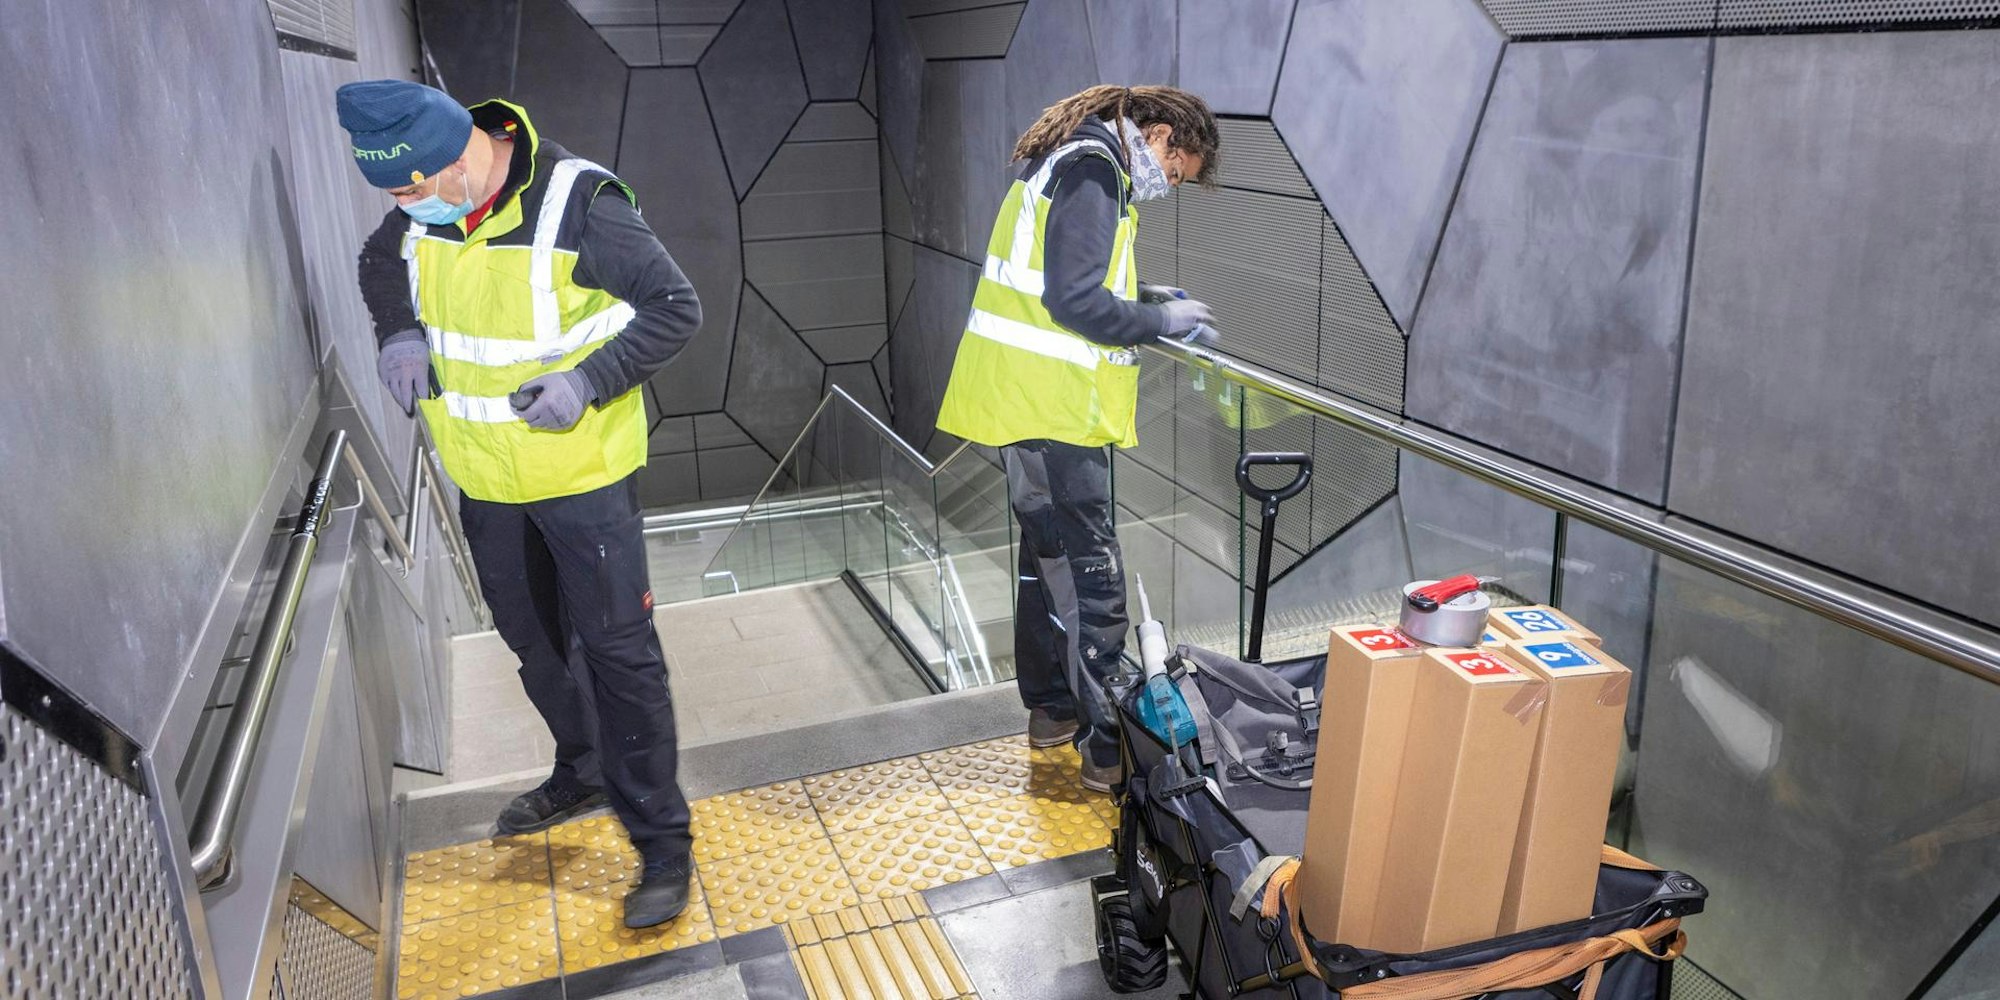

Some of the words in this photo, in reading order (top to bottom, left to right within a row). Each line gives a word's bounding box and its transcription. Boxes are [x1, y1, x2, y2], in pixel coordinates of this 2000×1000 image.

[1511, 611, 1560, 631] 26
[1361, 634, 1395, 646] 3
[1459, 658, 1494, 670] 3
